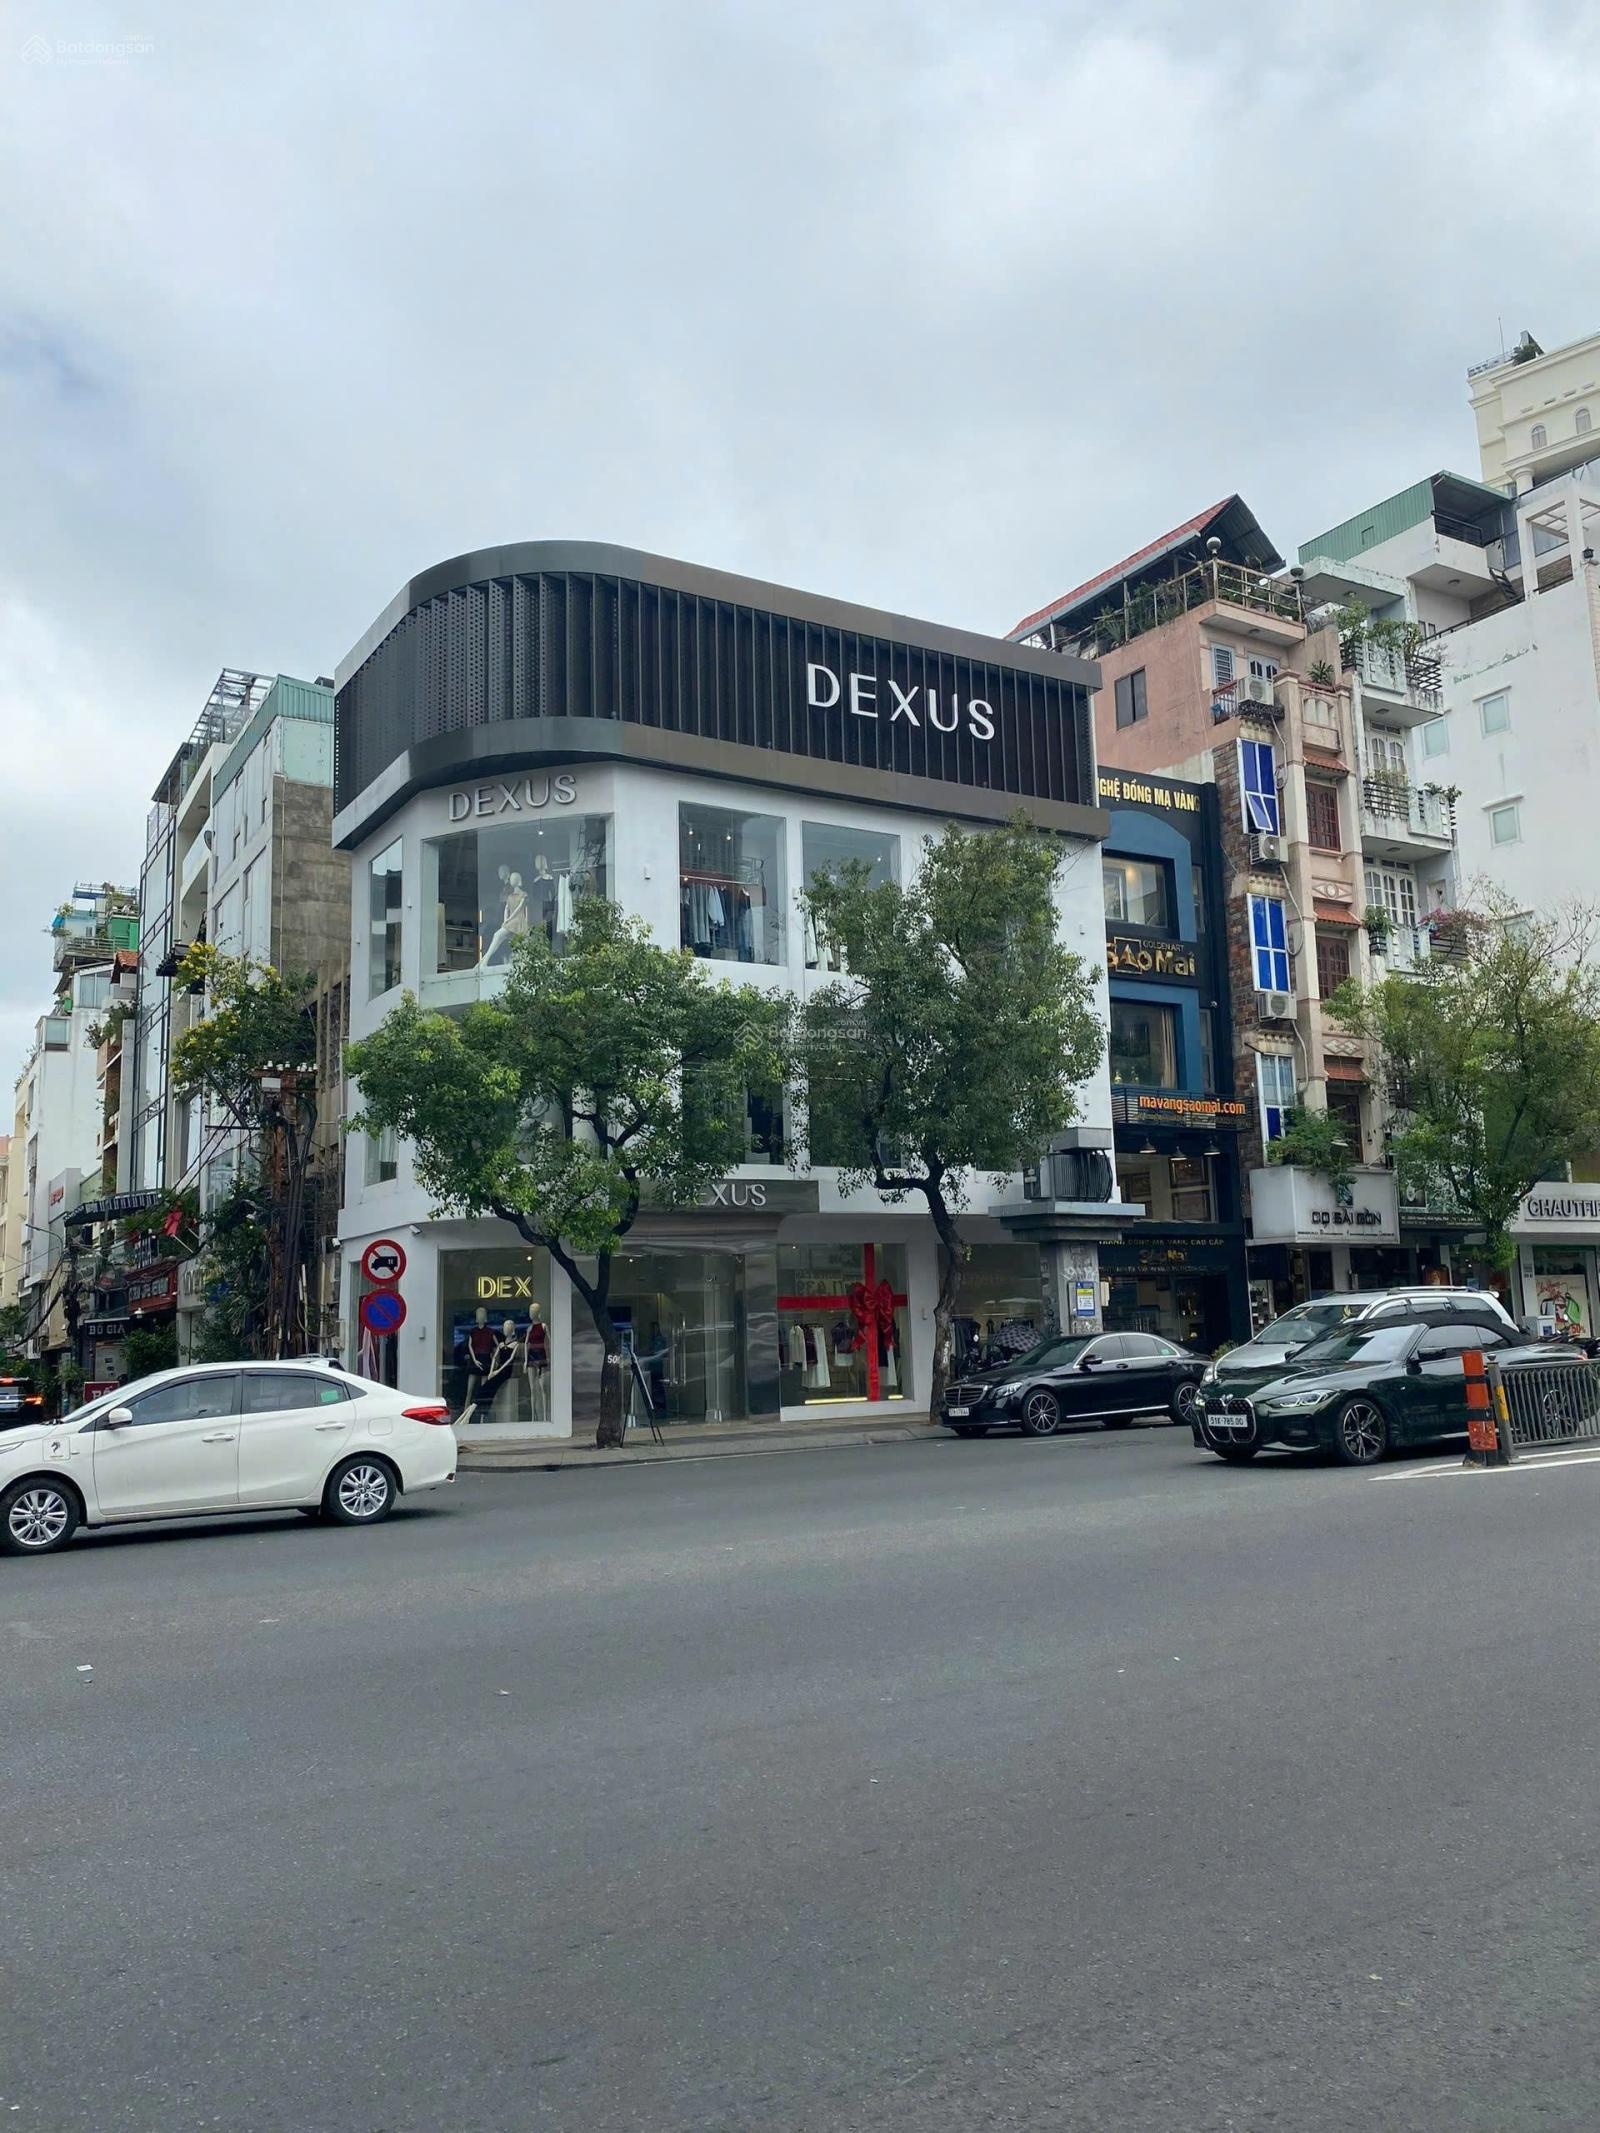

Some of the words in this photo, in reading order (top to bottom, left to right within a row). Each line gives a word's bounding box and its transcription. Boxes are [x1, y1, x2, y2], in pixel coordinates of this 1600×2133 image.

[807, 662, 995, 740] DEXUS
[449, 773, 577, 822] DEXUS
[1139, 1095, 1246, 1115] mavangsaomai.com
[477, 1276, 532, 1298] DEX
